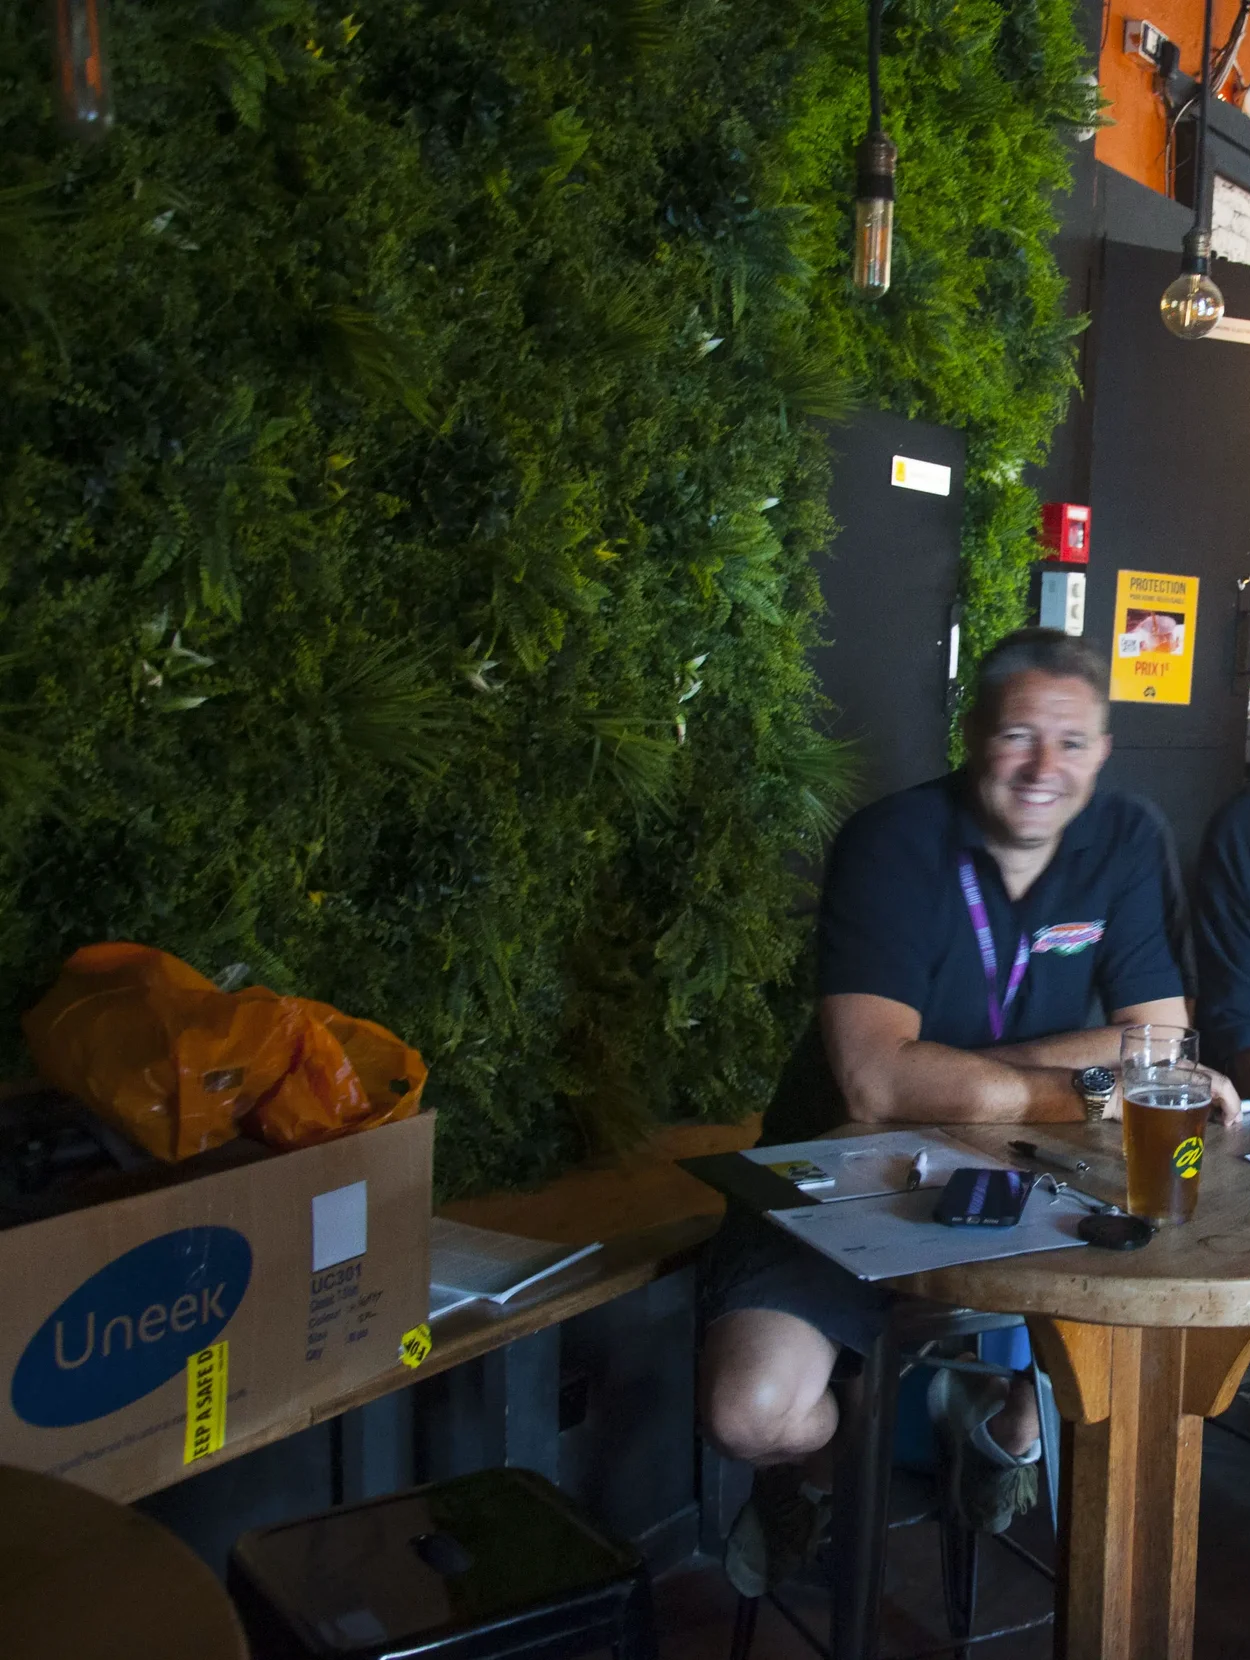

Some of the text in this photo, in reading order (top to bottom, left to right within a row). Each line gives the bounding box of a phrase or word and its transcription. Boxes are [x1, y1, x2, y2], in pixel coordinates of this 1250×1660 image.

[1129, 577, 1186, 595] PROTECTION
[1135, 660, 1158, 676] PRIX
[312, 1262, 362, 1295] UC301
[55, 1282, 228, 1370] Uneek
[196, 1366, 214, 1406] SAFE
[195, 1407, 212, 1421] A
